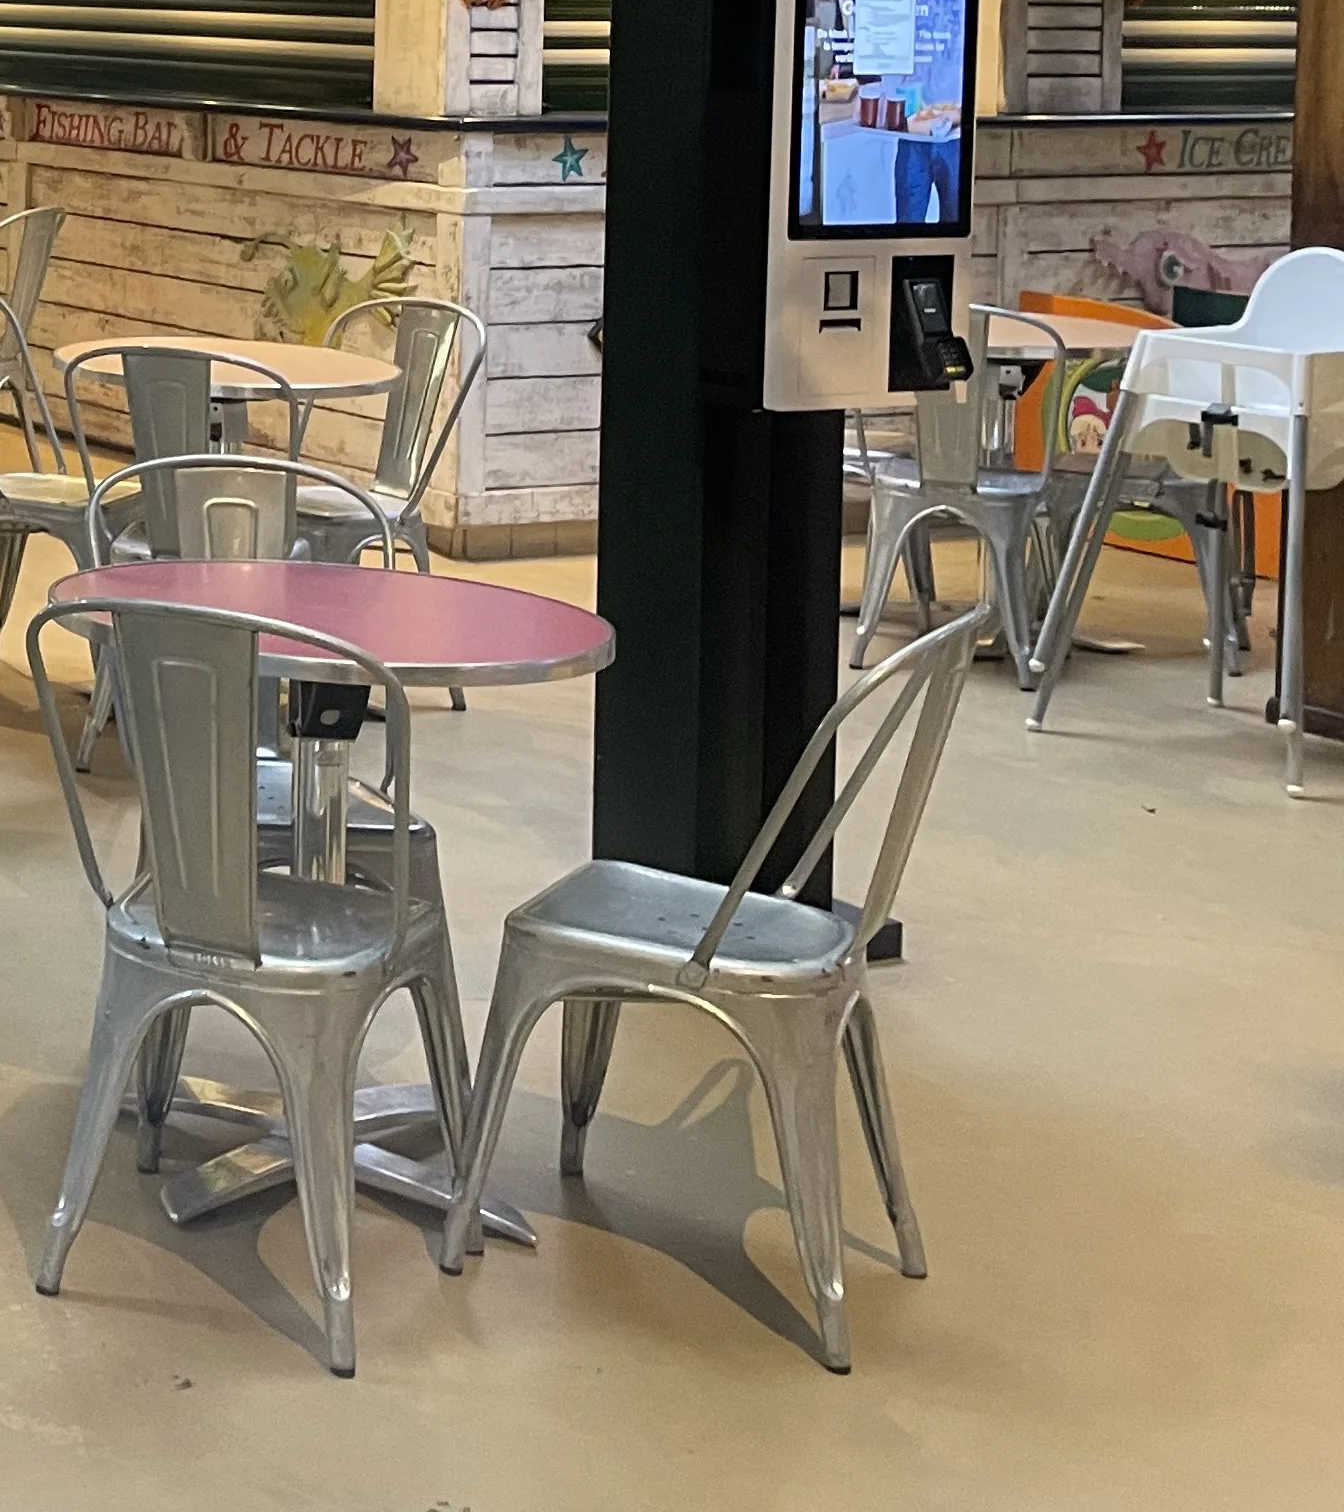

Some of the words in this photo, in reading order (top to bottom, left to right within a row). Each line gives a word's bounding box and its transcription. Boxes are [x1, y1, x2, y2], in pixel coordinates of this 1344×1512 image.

[33, 103, 124, 146] FISHING
[223, 122, 249, 162] &
[1178, 129, 1225, 169] ICE
[1233, 127, 1292, 168] CRE
